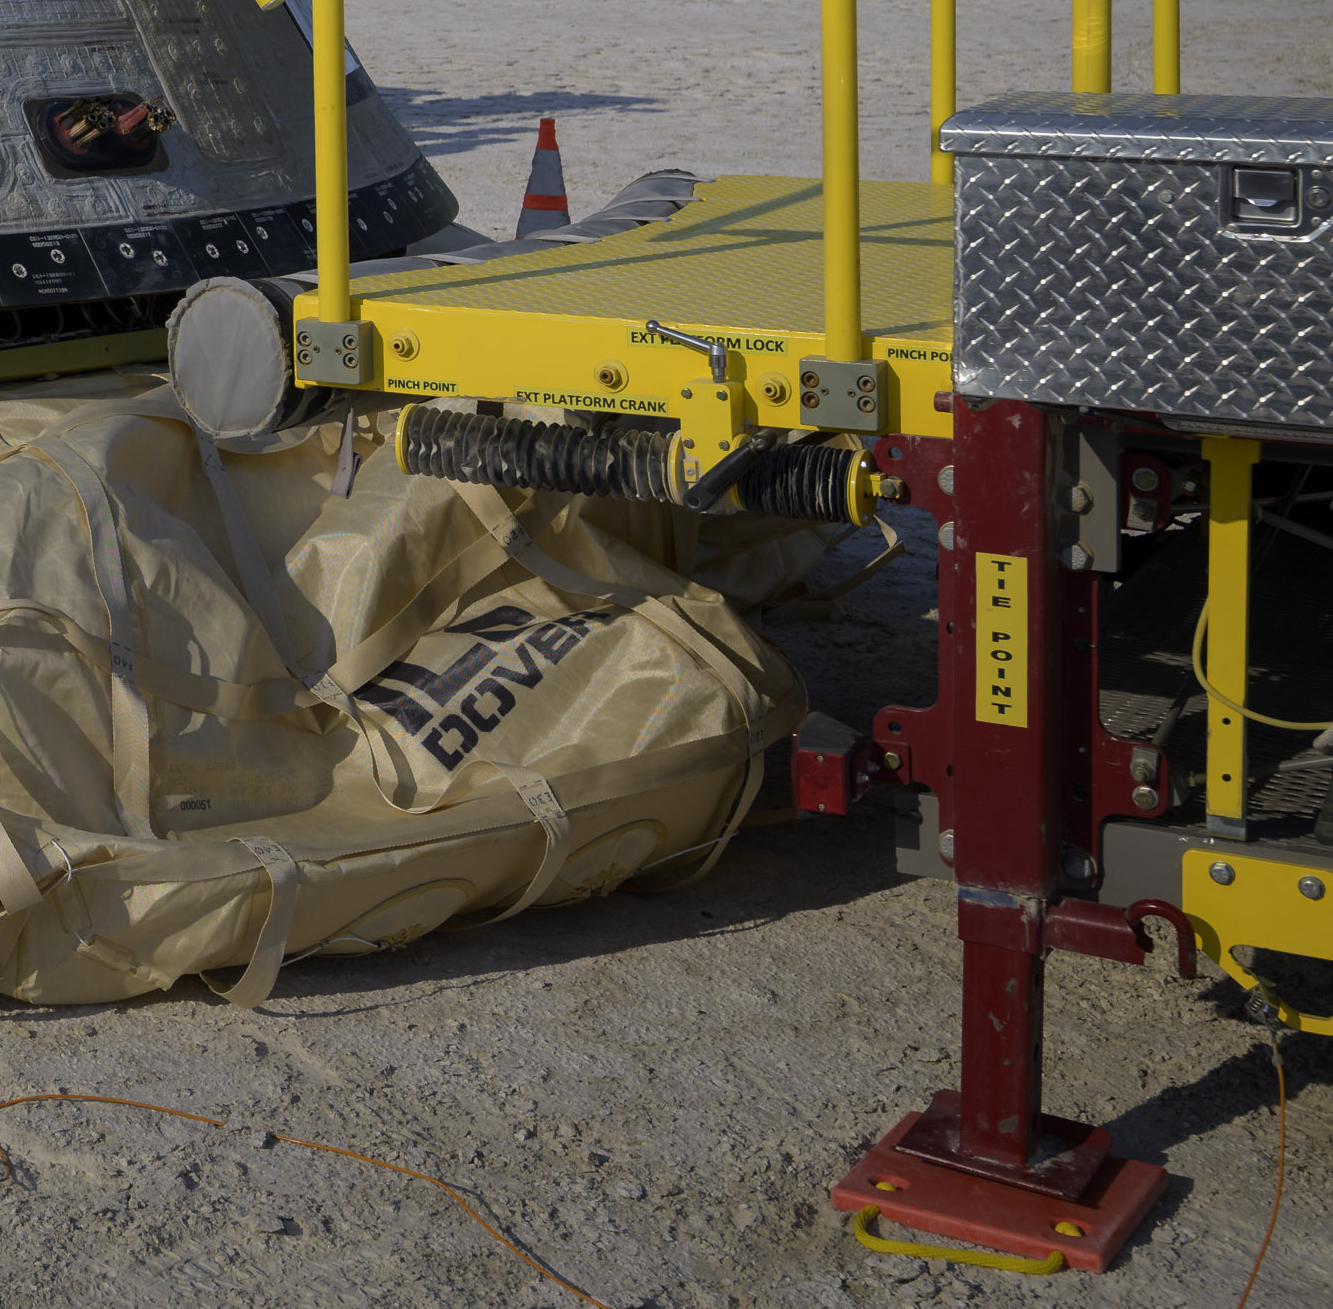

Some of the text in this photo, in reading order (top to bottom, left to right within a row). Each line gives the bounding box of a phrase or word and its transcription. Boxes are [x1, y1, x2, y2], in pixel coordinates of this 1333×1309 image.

[631, 331, 656, 344] EXT
[746, 338, 784, 353] LOCK
[888, 348, 927, 361] PINCH
[388, 378, 457, 393] PINCH POINT
[516, 391, 667, 413] EXT PLATFORM CRANK
[990, 560, 1012, 609] TIE
[990, 631, 1013, 714] POINT
[179, 798, 211, 812] 000051
